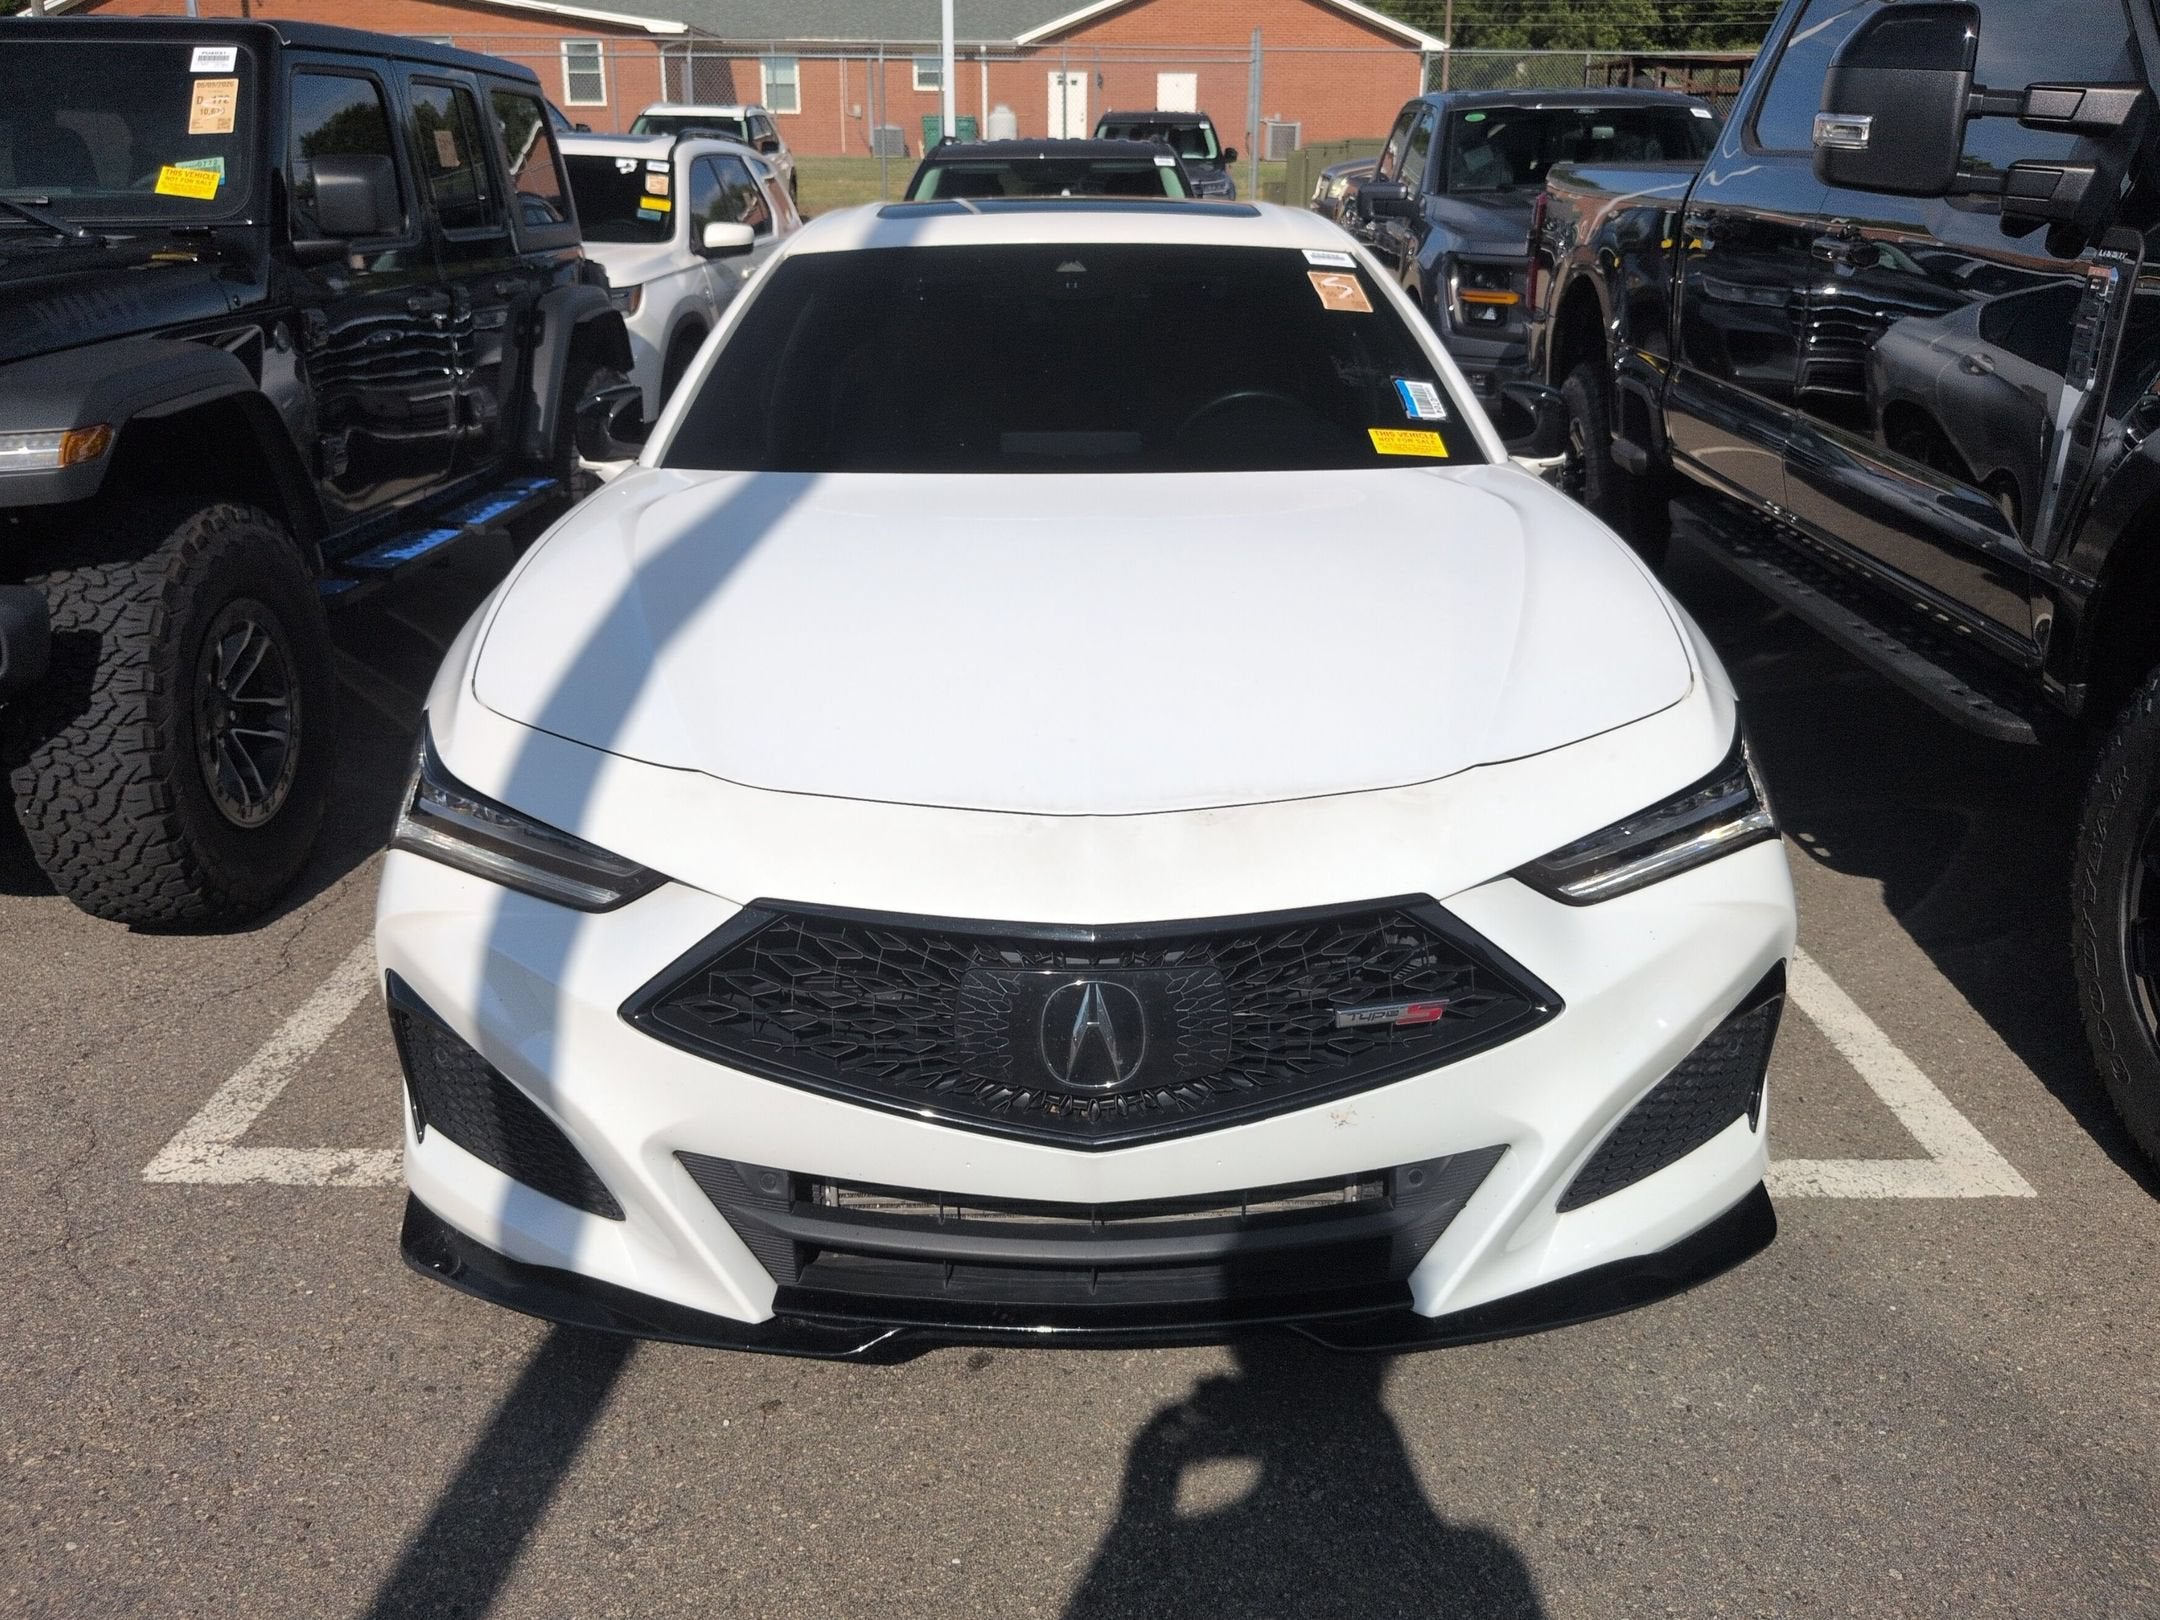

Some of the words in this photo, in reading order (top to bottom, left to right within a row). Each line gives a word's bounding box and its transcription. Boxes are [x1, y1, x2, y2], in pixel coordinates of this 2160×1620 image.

[197, 96, 204, 104] D
[166, 168, 182, 176] THIS
[186, 170, 217, 180] VEHICLE
[196, 178, 212, 186] SALE
[1397, 431, 1438, 440] VEHICLE
[2081, 765, 2131, 1086] GOODYEAR
[1347, 1009, 1400, 1022] TYPE
[1396, 1001, 1446, 1026] S
